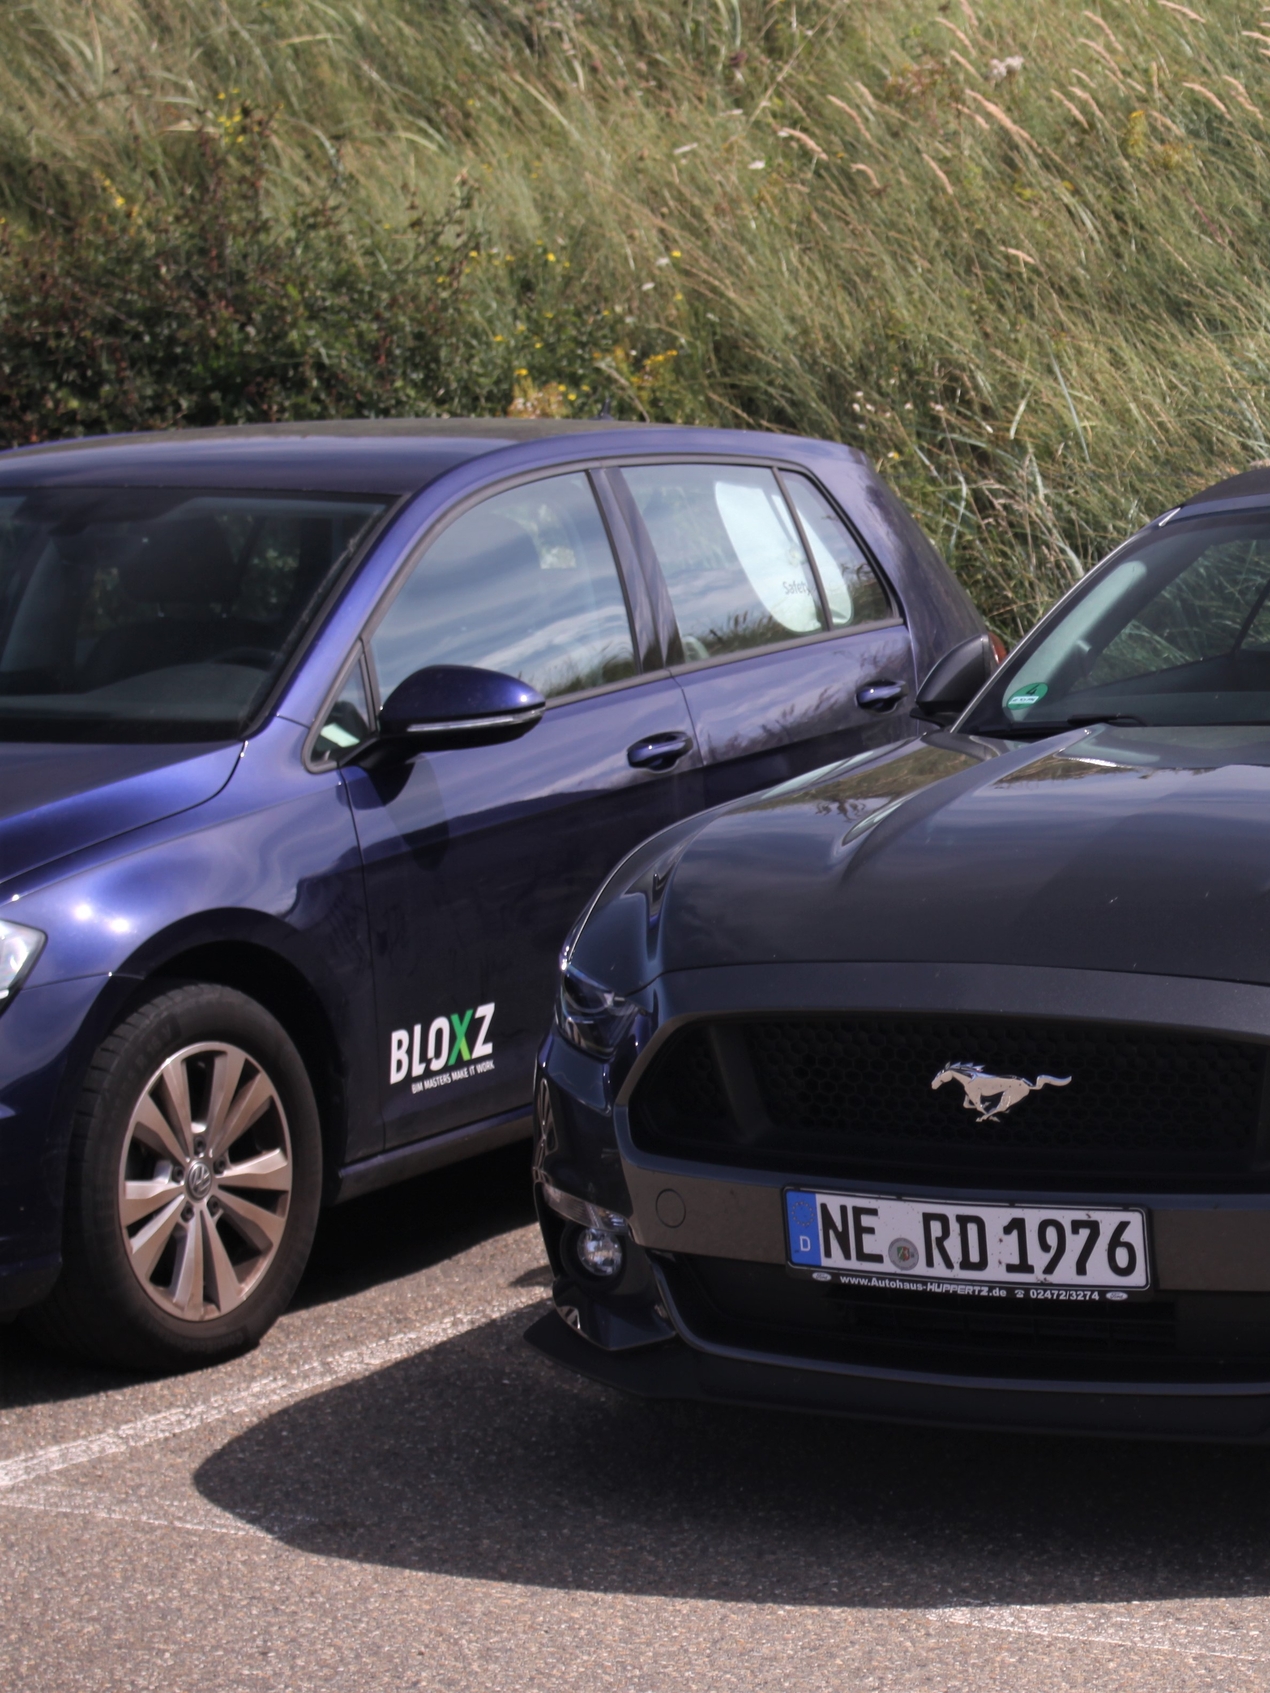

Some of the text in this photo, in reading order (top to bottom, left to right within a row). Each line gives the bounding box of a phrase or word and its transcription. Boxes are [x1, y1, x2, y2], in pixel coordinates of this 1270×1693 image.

[390, 1002, 495, 1085] BLOXZ
[411, 1060, 496, 1095] BIM MASTERS MAKE IT WORK
[799, 1235, 811, 1252] D
[820, 1202, 1138, 1278] NE RD 1976
[1029, 1288, 1100, 1300] 02472/3274
